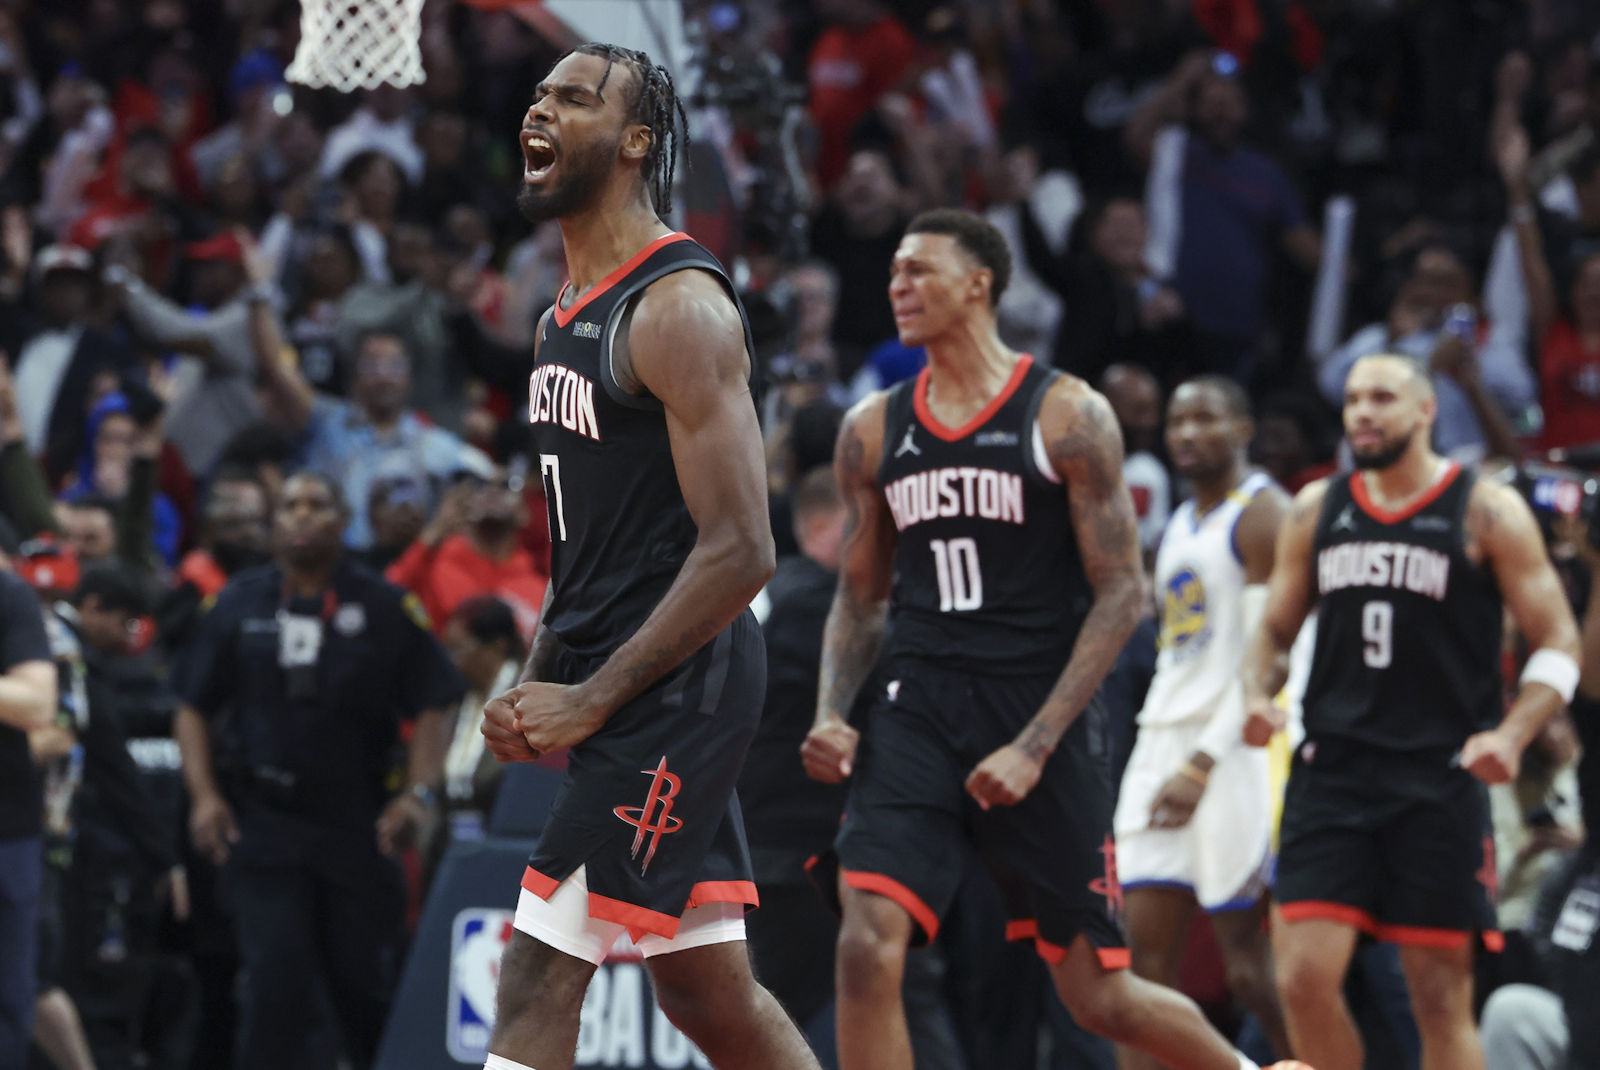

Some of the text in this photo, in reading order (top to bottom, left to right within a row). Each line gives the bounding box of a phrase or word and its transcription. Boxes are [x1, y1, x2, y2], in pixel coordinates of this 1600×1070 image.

[529, 363, 600, 441] OUSTON
[540, 454, 567, 541] 7
[884, 466, 1025, 533] HOUSTON
[930, 537, 984, 613] 10
[1318, 541, 1450, 602] HOUSTON
[1362, 600, 1394, 670] 9
[574, 962, 646, 1068] BA
